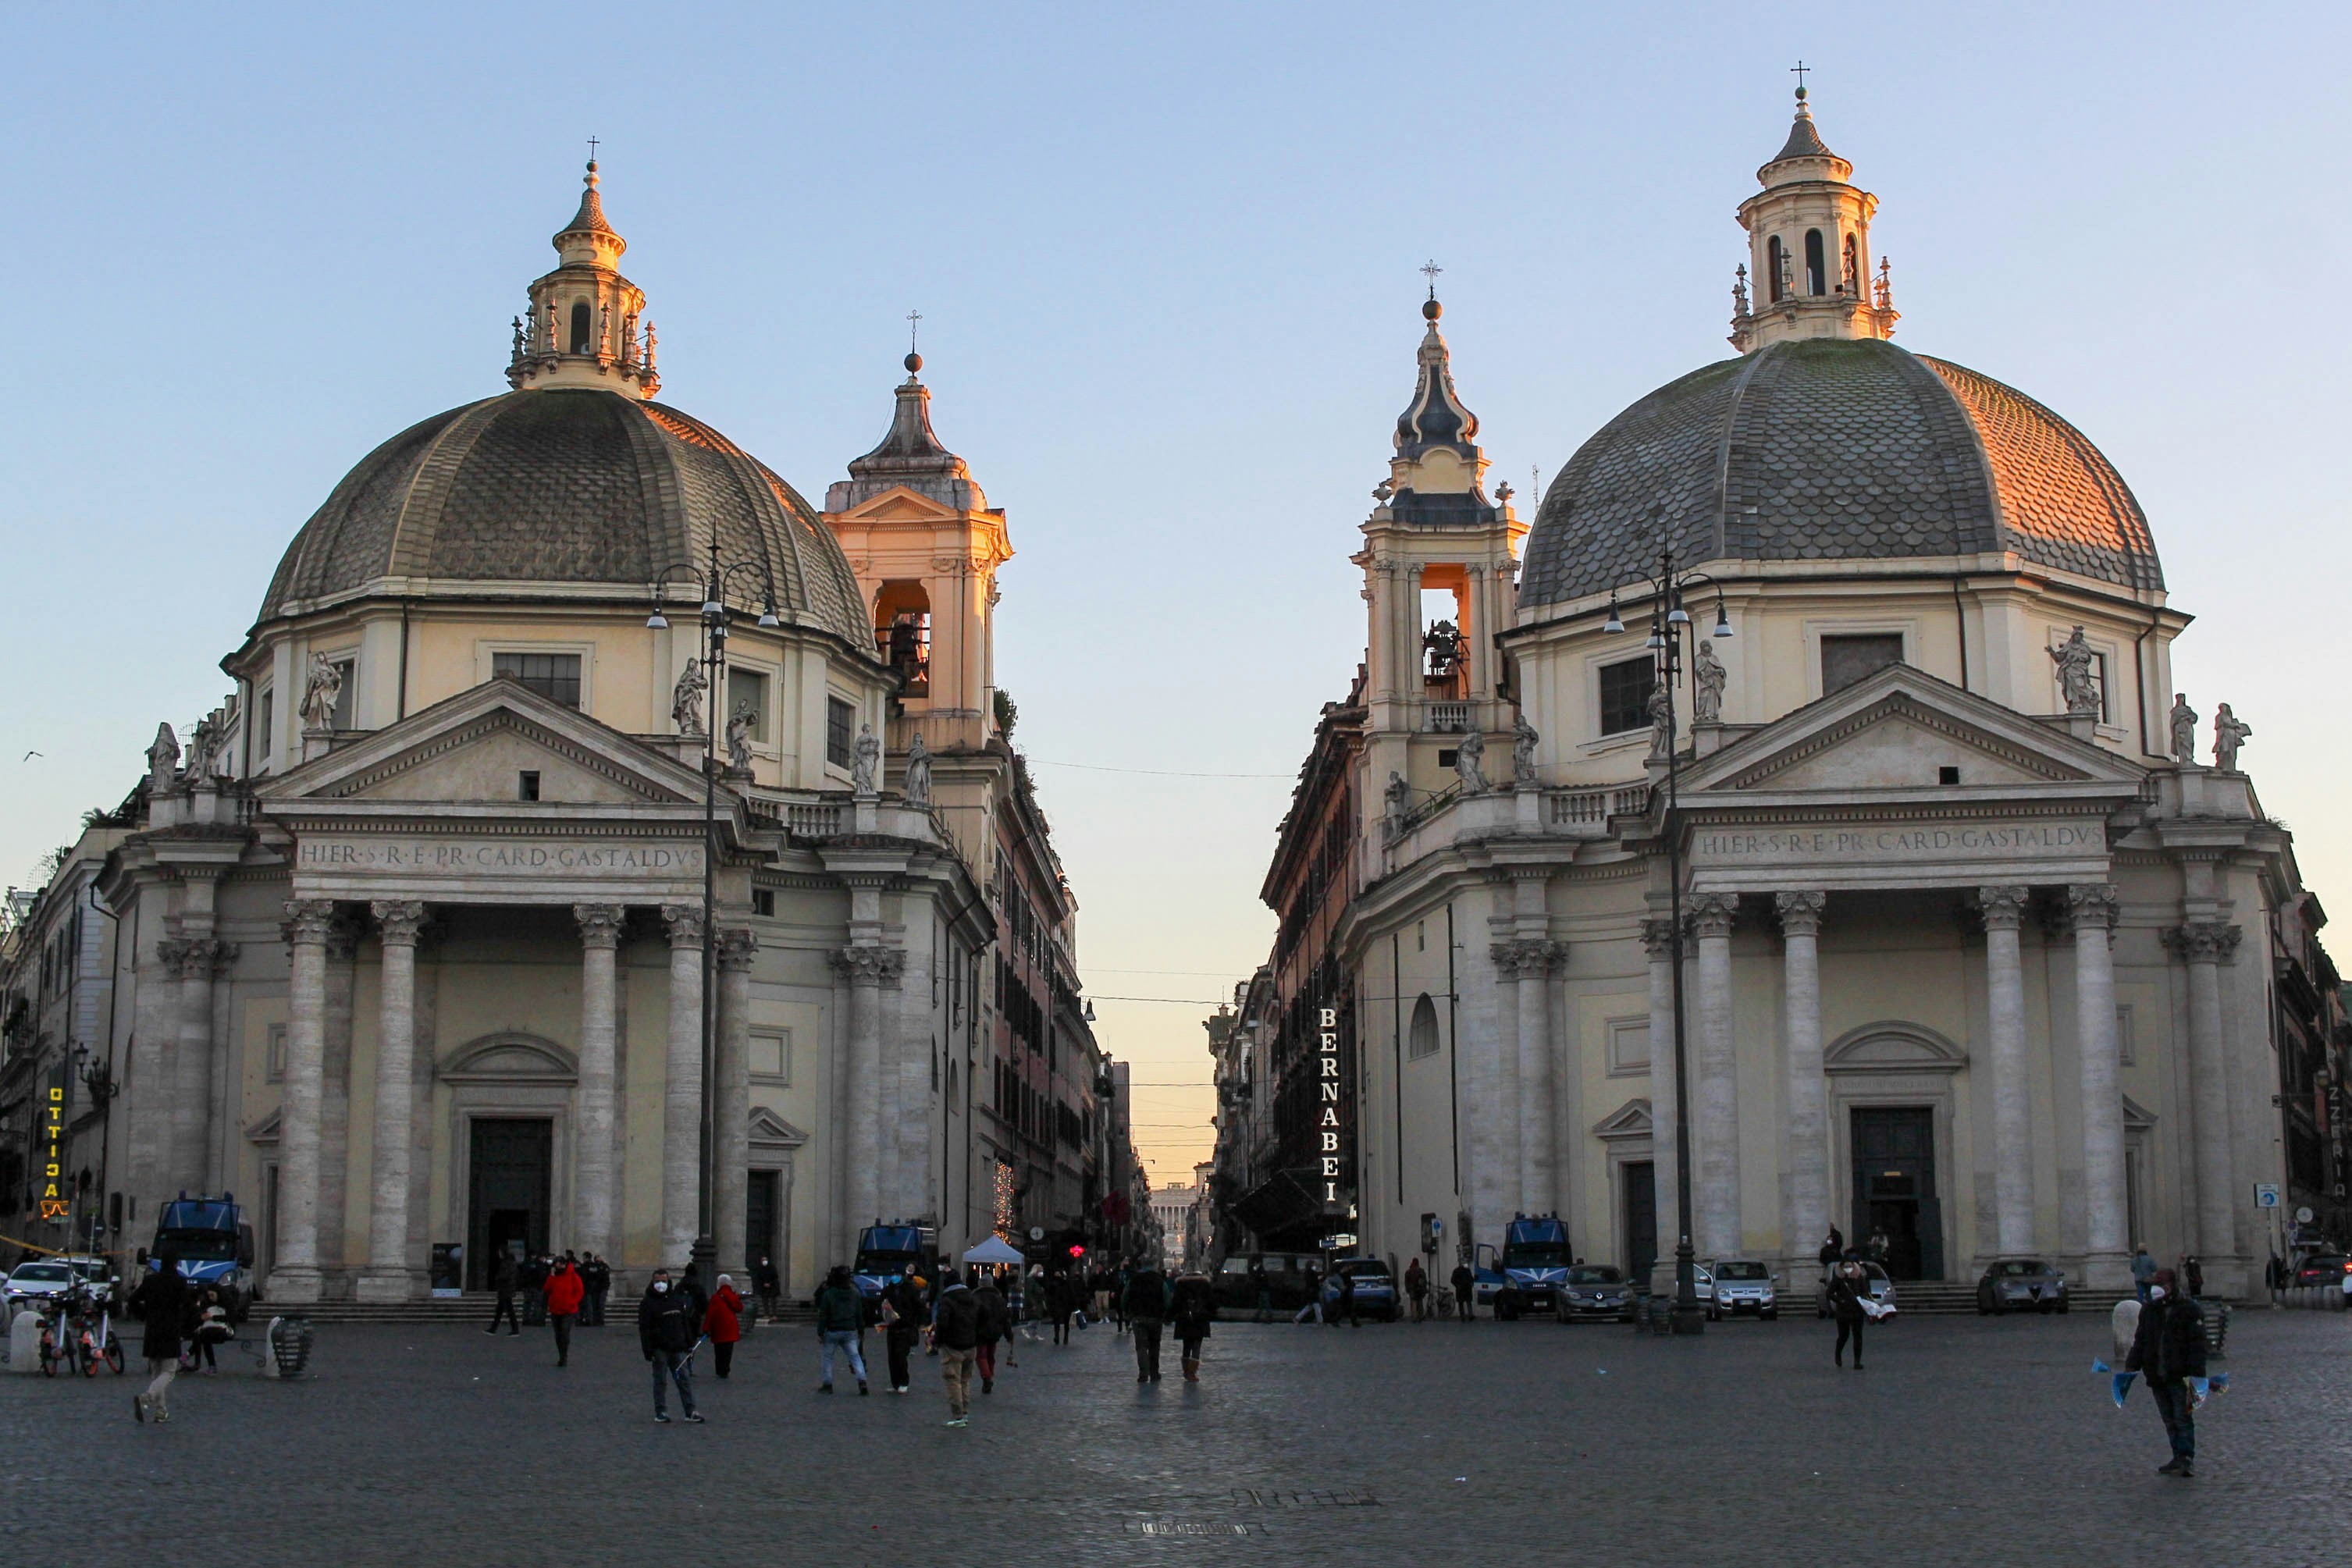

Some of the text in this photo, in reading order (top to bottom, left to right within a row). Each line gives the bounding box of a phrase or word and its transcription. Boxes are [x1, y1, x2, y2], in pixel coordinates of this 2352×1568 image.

[1702, 835, 1760, 855] HIER
[1877, 830, 1951, 851] CARD
[1961, 827, 2102, 848] GASTALDVS
[301, 844, 360, 864] HIER
[476, 848, 546, 867] CARD
[558, 848, 699, 868] GASTALDVS
[1320, 1008, 1339, 1201] BERNABEI
